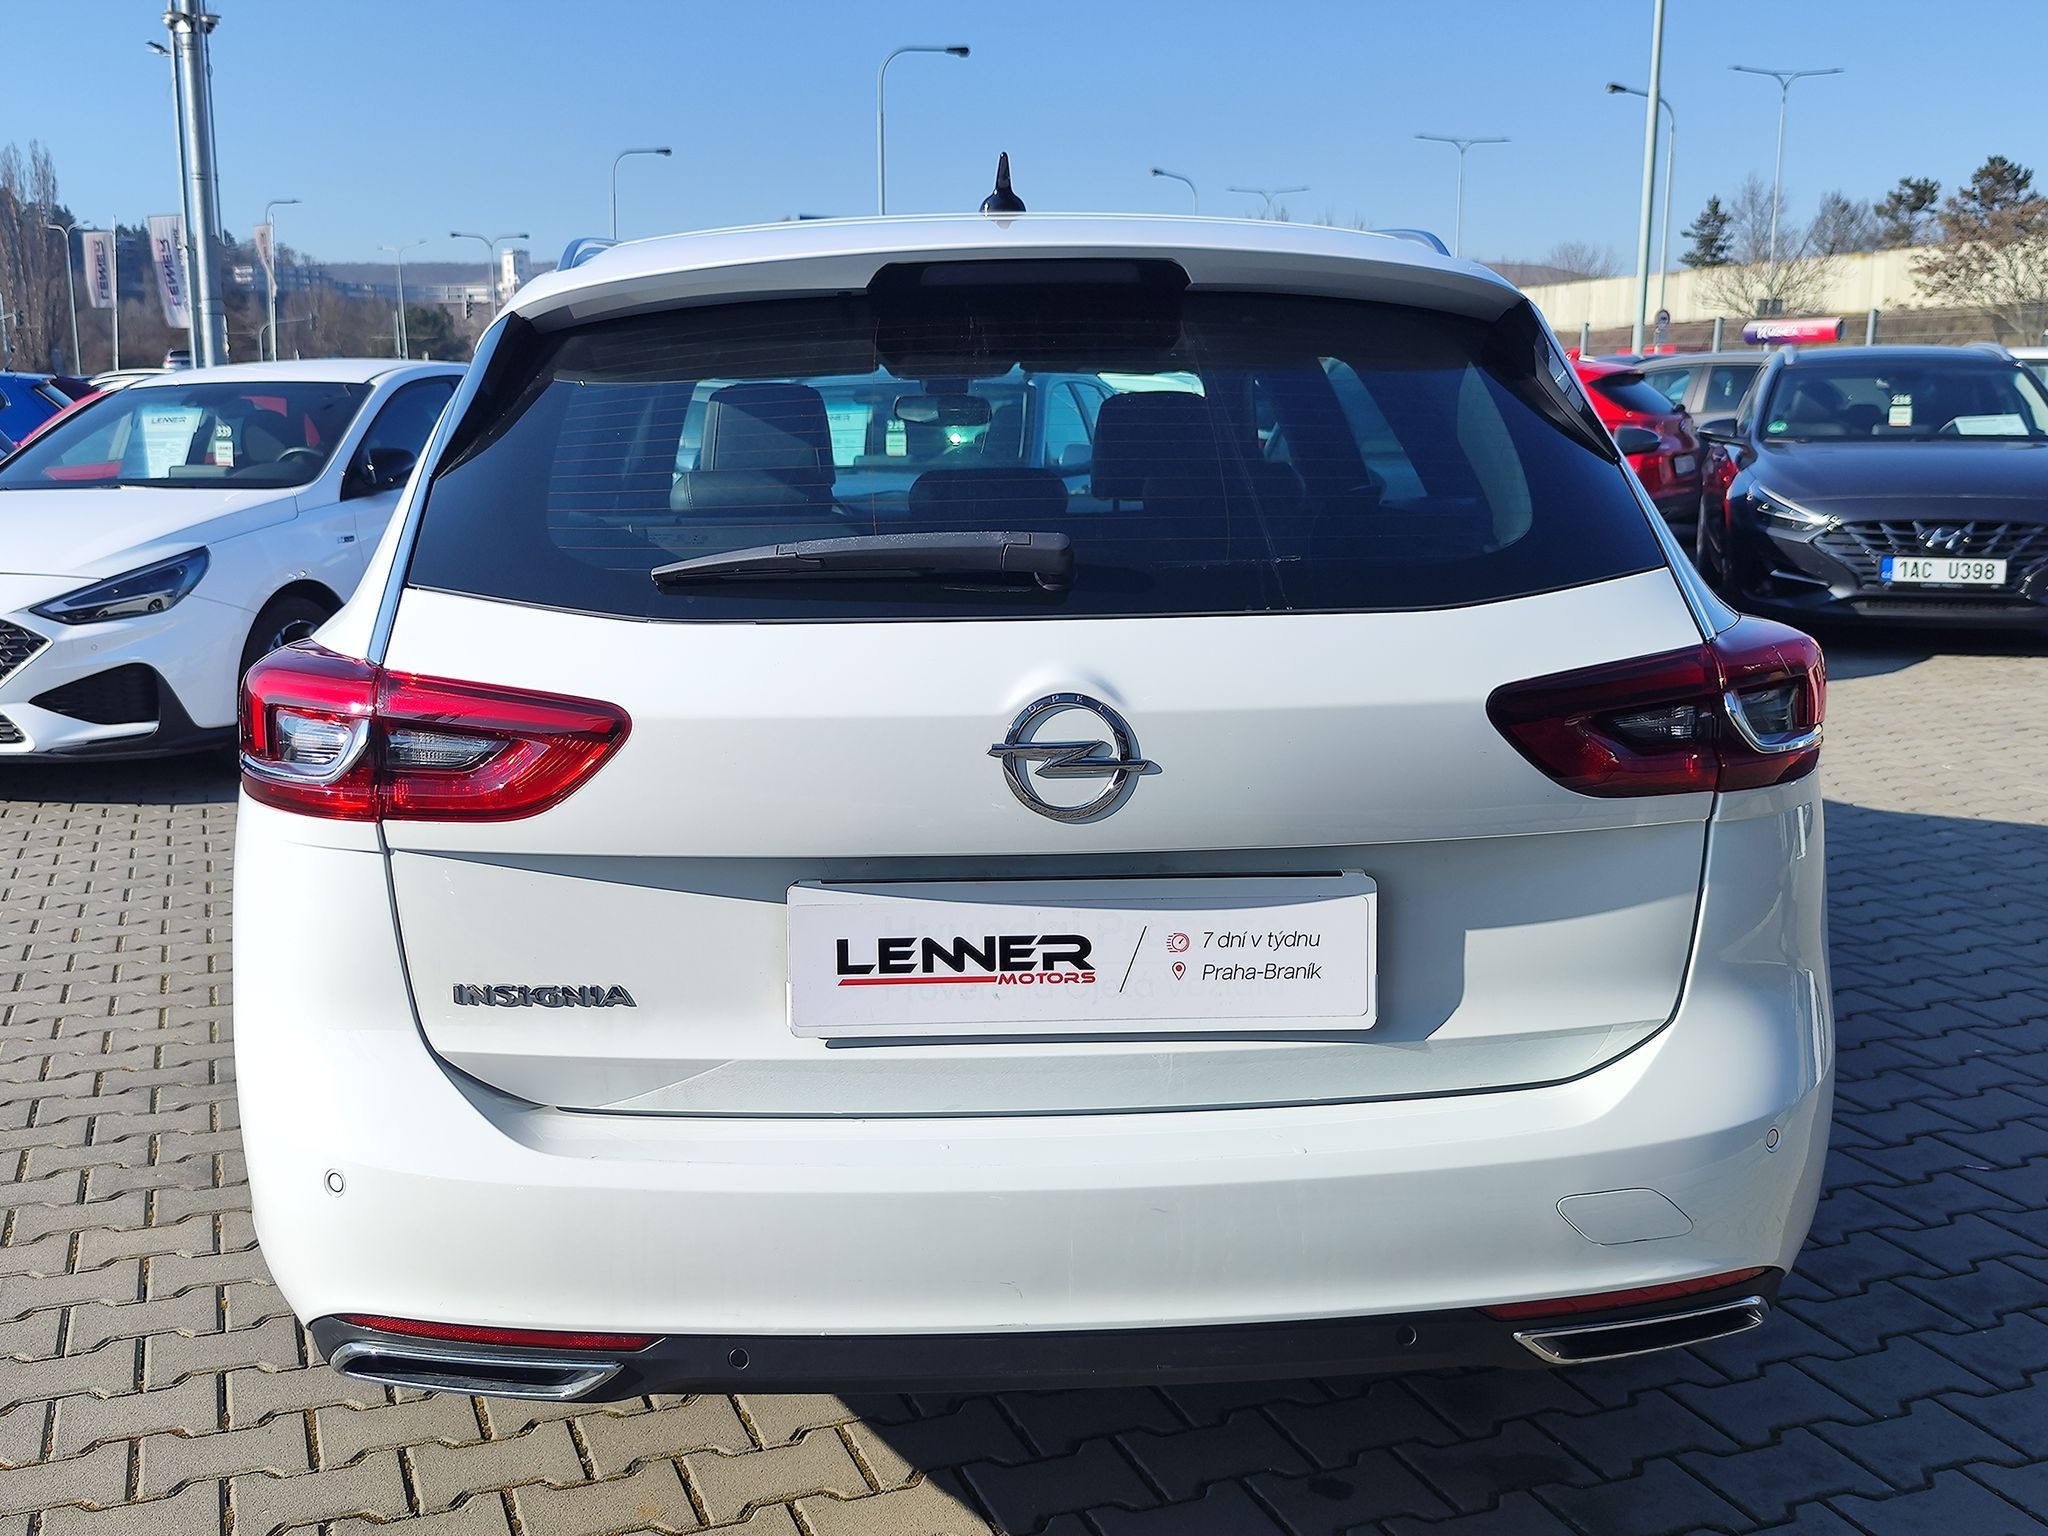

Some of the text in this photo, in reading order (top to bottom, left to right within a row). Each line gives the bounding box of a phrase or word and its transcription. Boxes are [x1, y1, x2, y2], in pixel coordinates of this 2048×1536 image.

[1898, 561, 1996, 580] 1AC U398
[1203, 930, 1321, 952] 7 dní v týdnu
[836, 934, 1096, 975] LENNER
[997, 971, 1097, 985] MOTORS
[1202, 962, 1323, 981] Praha-Braník
[452, 983, 637, 1009] INSIGNIA
